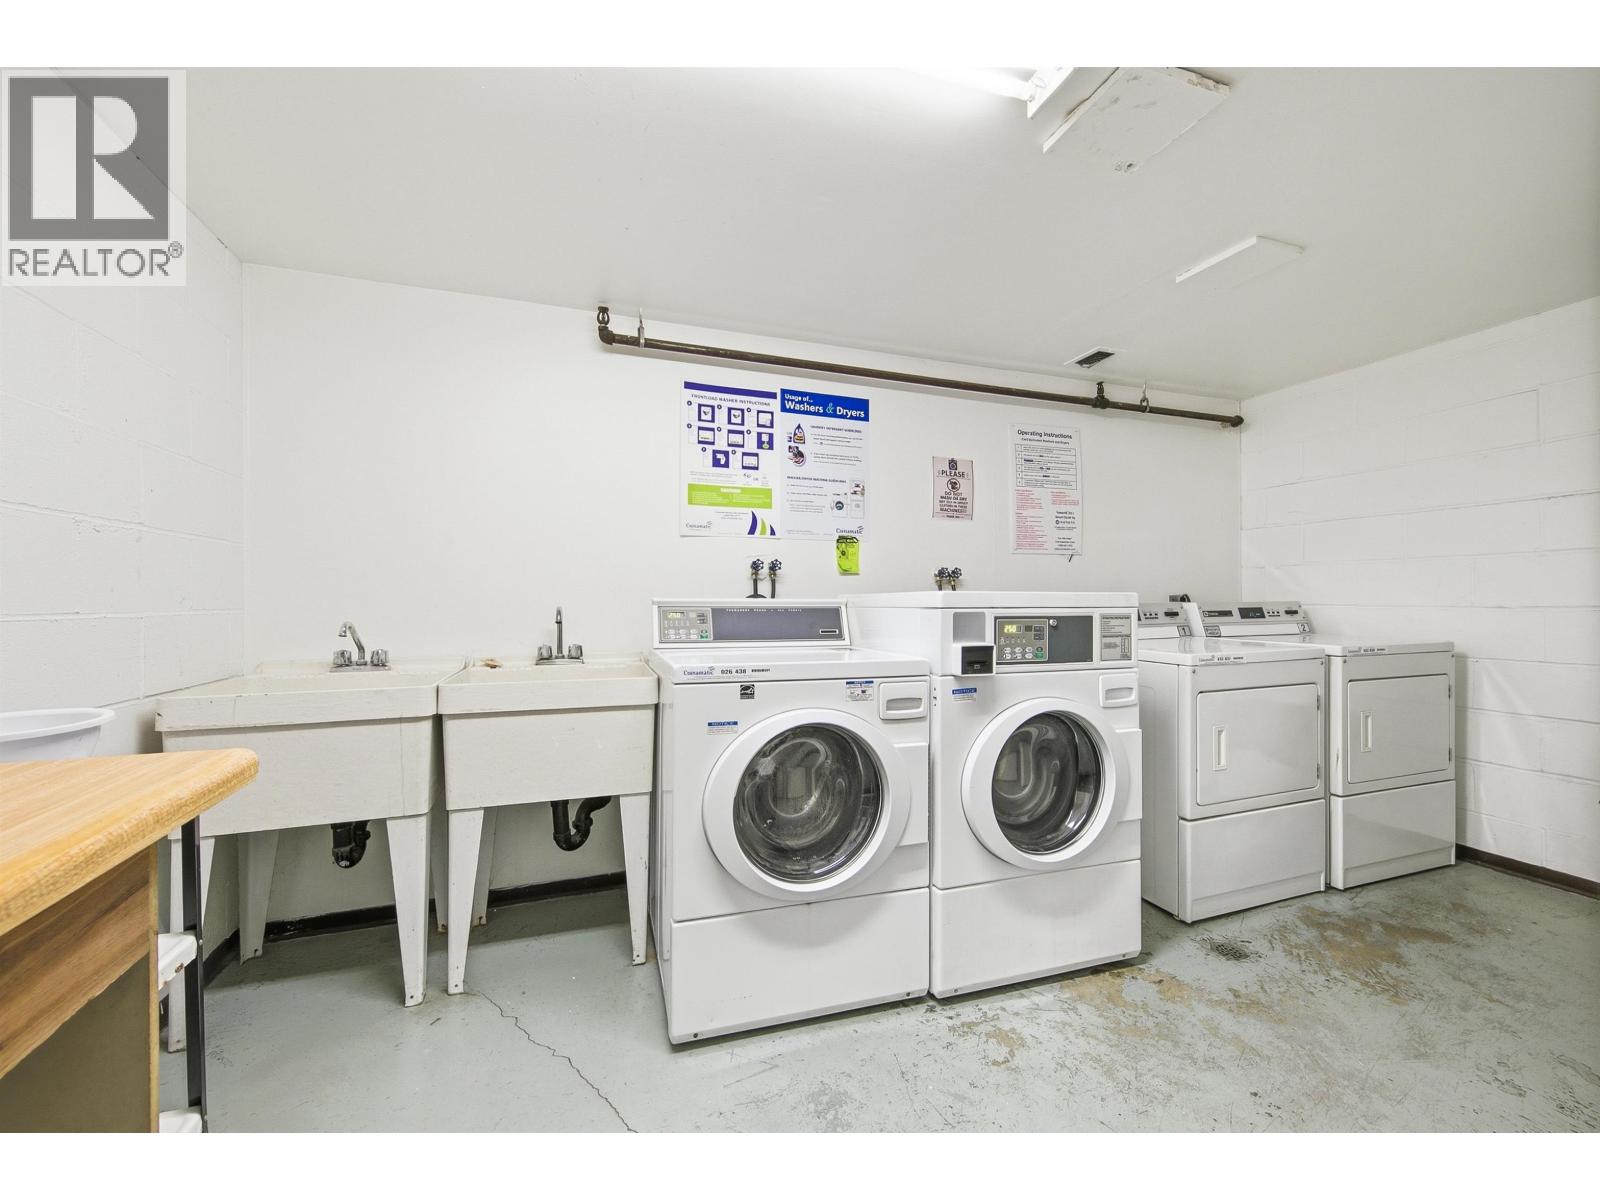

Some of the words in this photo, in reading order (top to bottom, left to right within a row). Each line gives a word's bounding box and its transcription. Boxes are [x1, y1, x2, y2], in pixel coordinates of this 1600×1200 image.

[784, 393, 801, 403] Usage
[784, 400, 824, 414] Washers
[825, 402, 835, 414] &
[836, 406, 865, 418] Dryers
[1017, 429, 1043, 438] Operating
[1043, 431, 1073, 440] Instructions
[941, 469, 966, 478] PLEASE
